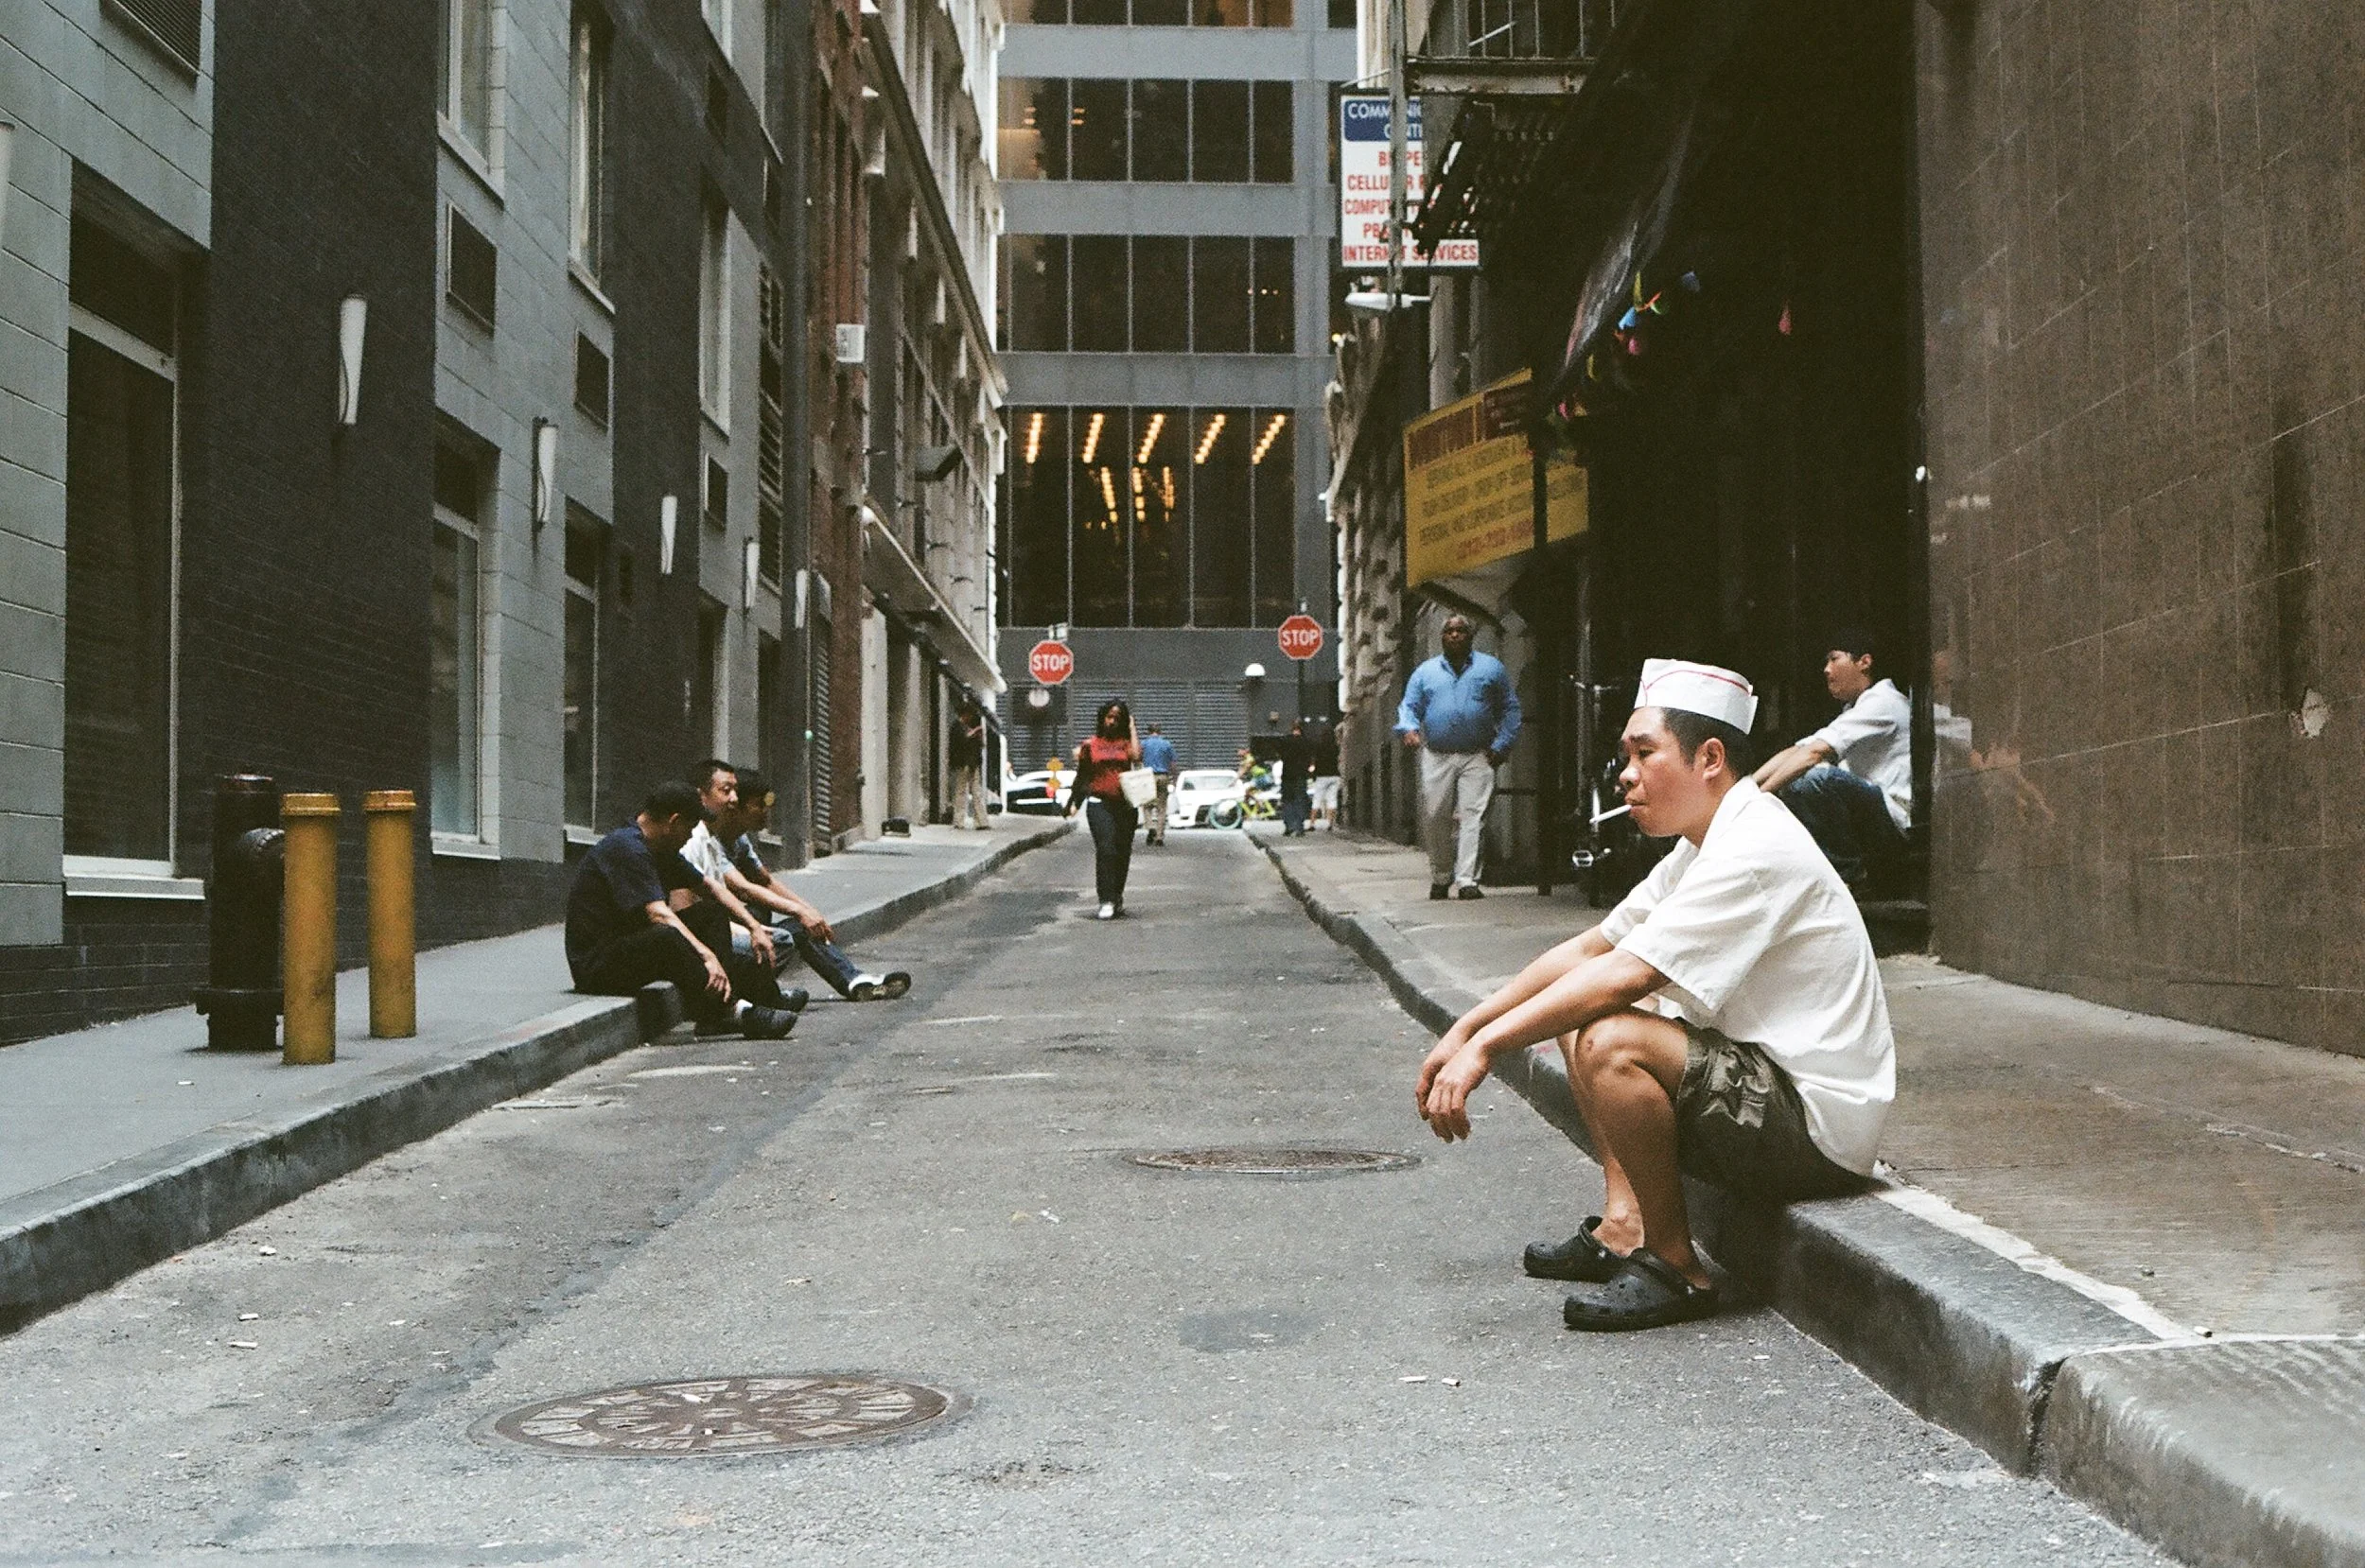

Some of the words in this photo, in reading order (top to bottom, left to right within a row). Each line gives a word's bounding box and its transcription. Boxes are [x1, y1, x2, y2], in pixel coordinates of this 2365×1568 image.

[1347, 174, 1413, 191] CELLUR
[1344, 245, 1406, 261] INTERNT
[1282, 629, 1318, 646] STOP
[1033, 653, 1069, 671] STOP
